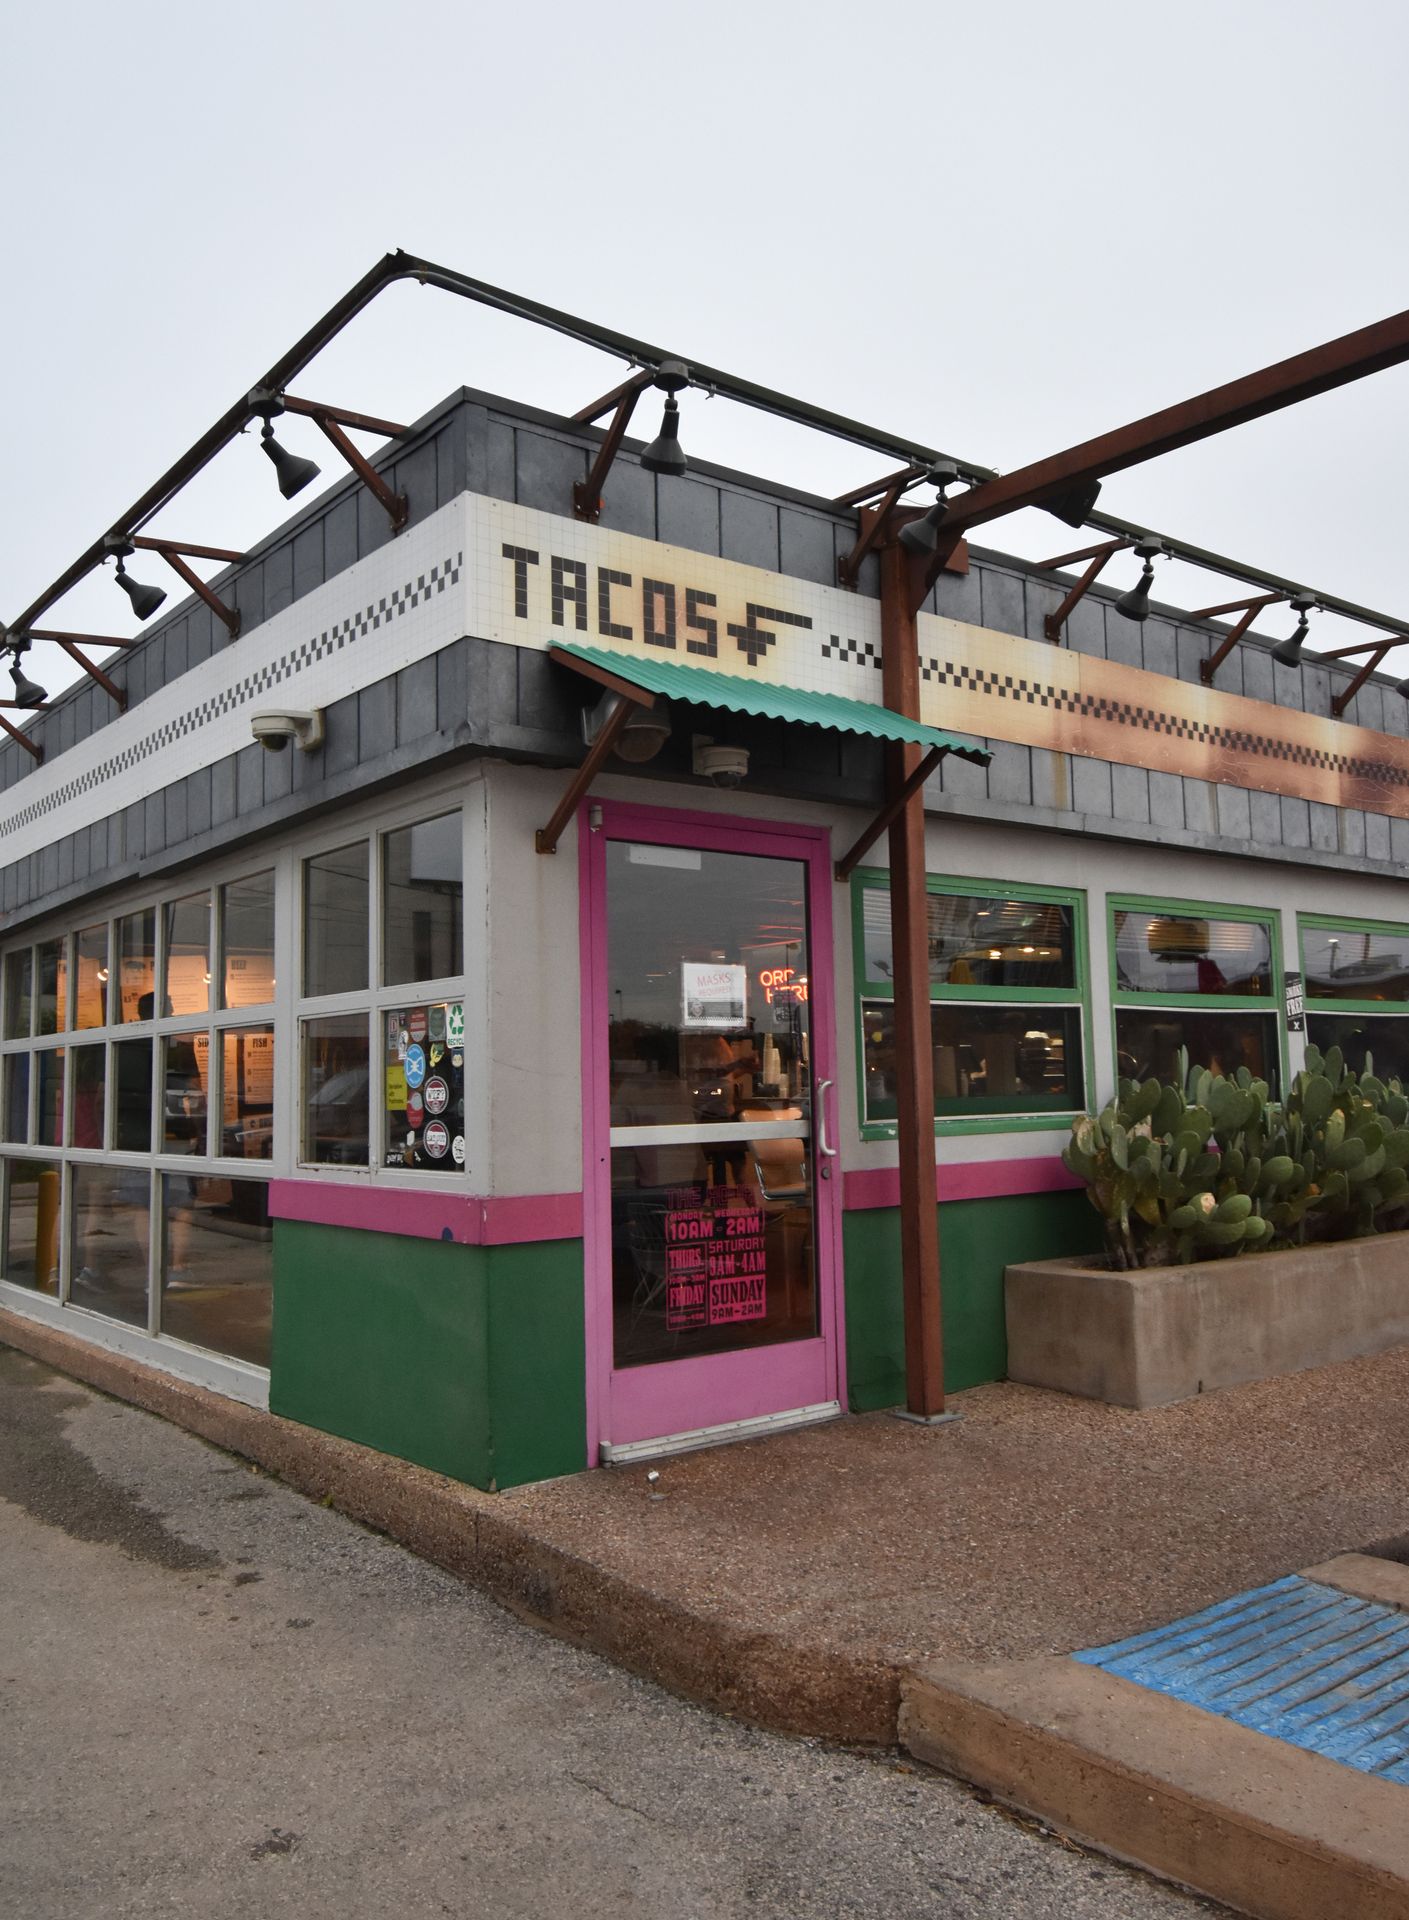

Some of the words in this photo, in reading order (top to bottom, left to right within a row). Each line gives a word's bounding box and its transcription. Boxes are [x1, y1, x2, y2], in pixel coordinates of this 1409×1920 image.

[502, 543, 718, 658] TACOS
[697, 971, 732, 987] MASKS
[1286, 997, 1303, 1016] FREE
[252, 1037, 268, 1048] FISH
[664, 1187, 702, 1209] THE
[670, 1211, 703, 1222] MONDAY
[670, 1220, 713, 1241] 10AM
[726, 1216, 759, 1236] 2AM
[709, 1237, 766, 1254] SATURDAY
[669, 1285, 705, 1307] FRIDAY
[712, 1279, 764, 1306] SUNDAY
